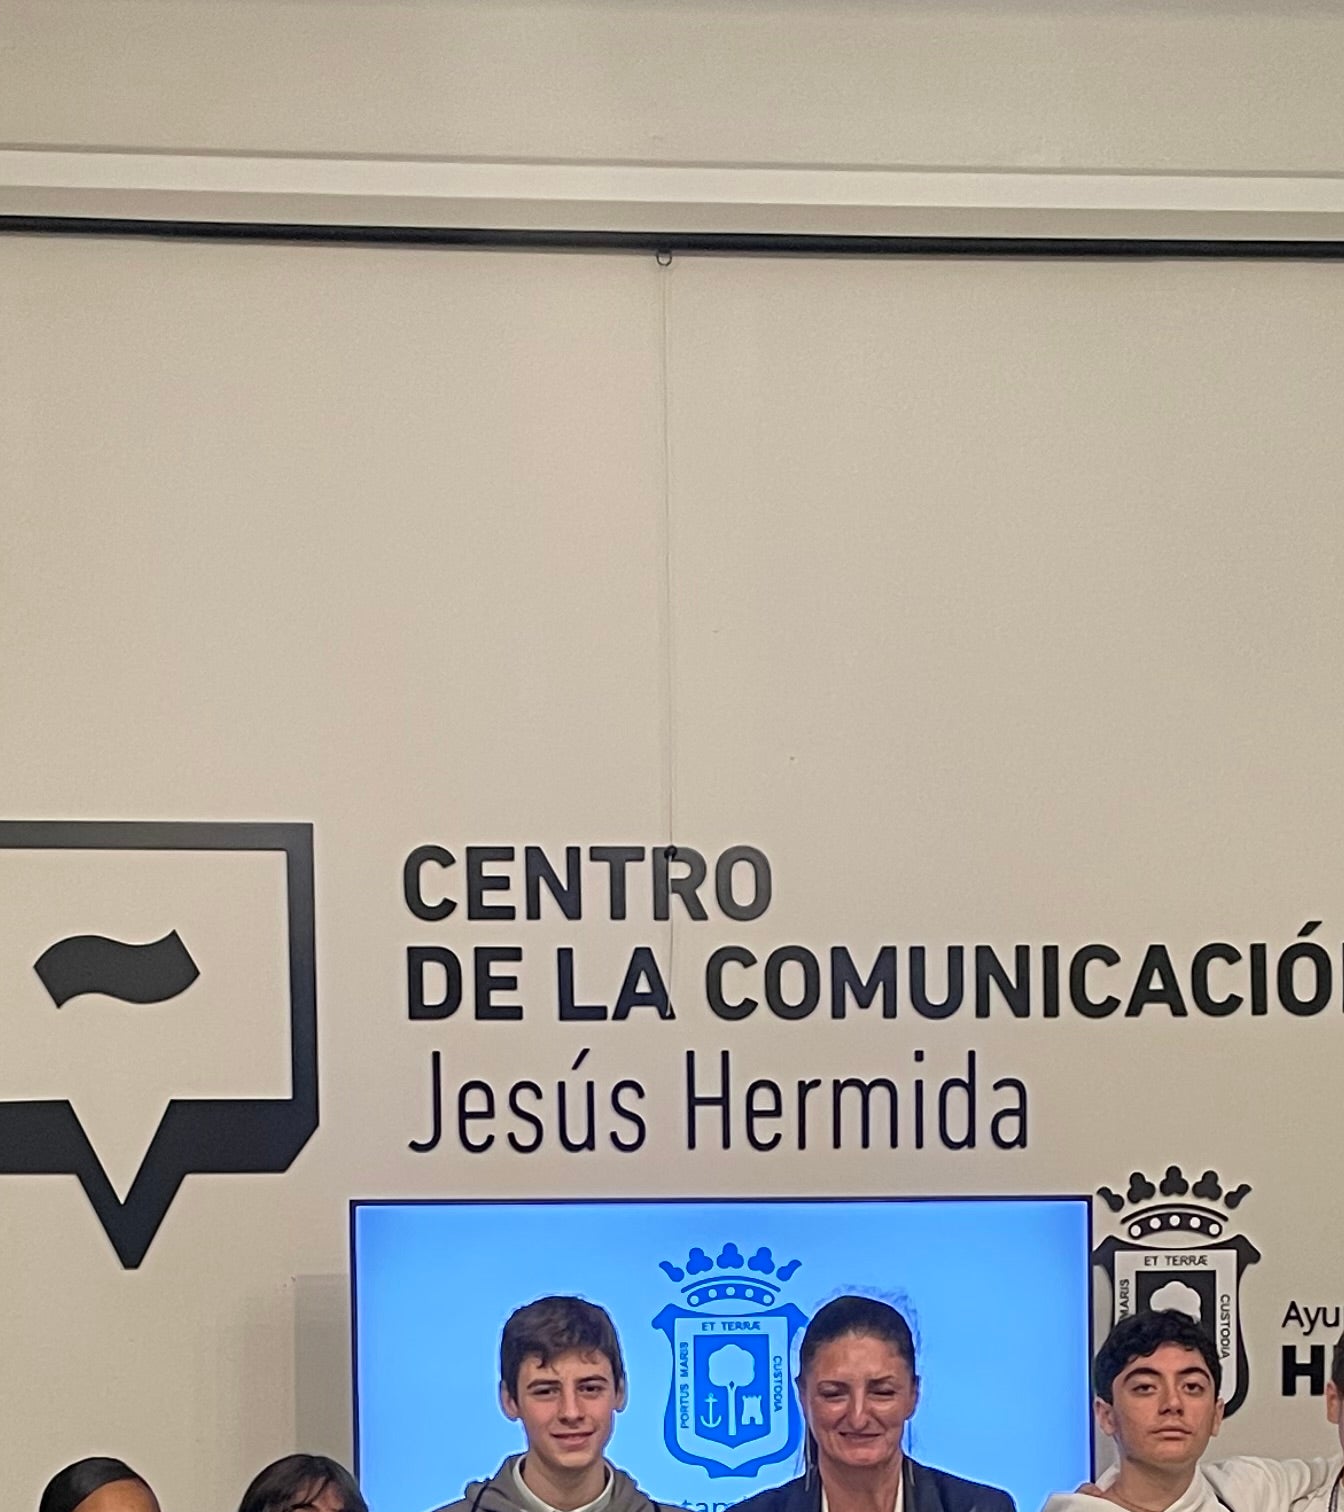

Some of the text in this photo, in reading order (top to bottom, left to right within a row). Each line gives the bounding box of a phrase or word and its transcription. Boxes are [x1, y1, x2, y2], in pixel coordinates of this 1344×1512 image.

[403, 844, 773, 922] CENTRO
[406, 946, 524, 1021] DE
[556, 946, 677, 1021] LA
[407, 1048, 1028, 1153] Jesús Hermida
[1143, 1255, 1158, 1266] ET
[701, 1321, 715, 1331] ET
[1219, 1294, 1231, 1358] CUSTODIA
[679, 1341, 689, 1429] PORTUS MARIS
[772, 1354, 783, 1411] CUSTODIA
